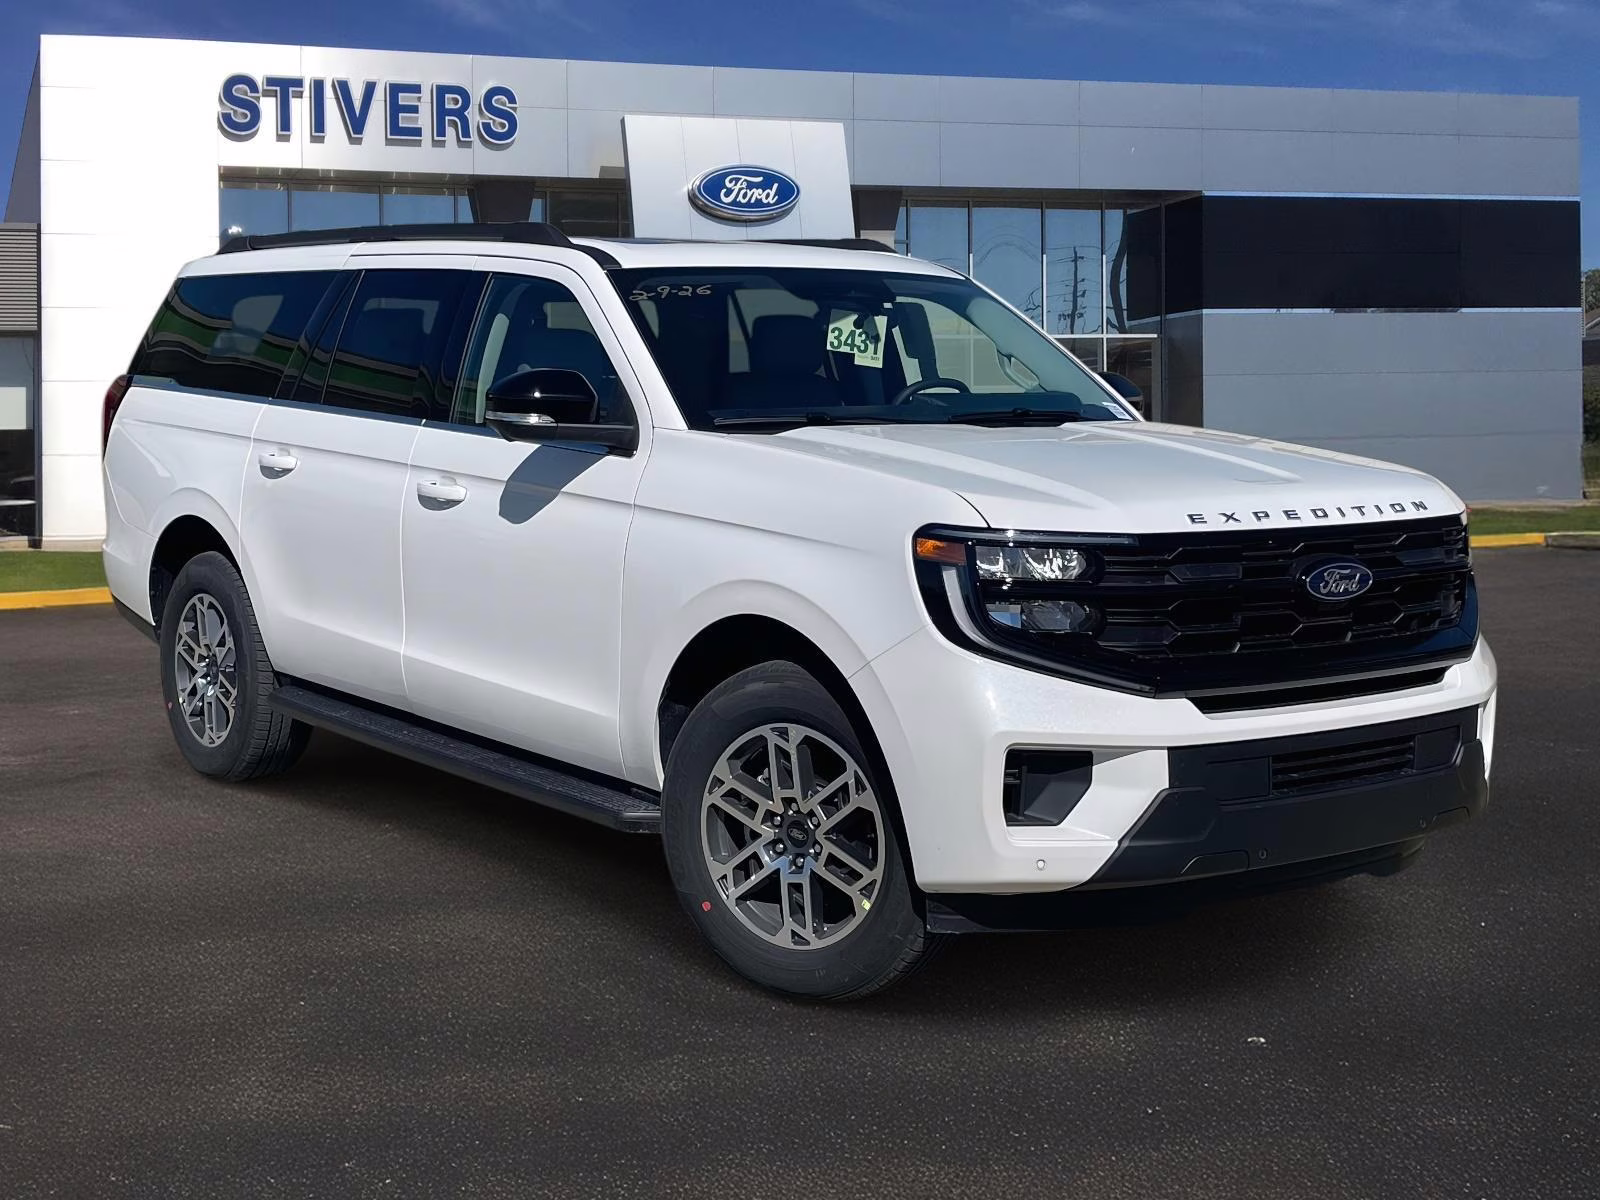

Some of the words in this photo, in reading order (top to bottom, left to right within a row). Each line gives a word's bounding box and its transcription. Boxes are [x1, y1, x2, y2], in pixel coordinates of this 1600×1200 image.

[218, 73, 519, 148] STIVERS
[720, 174, 779, 204] Ford
[629, 284, 712, 301] 2-9-26
[829, 326, 881, 355] 3431
[1187, 500, 1429, 525] EXPEDITION
[1319, 568, 1360, 594] Ford
